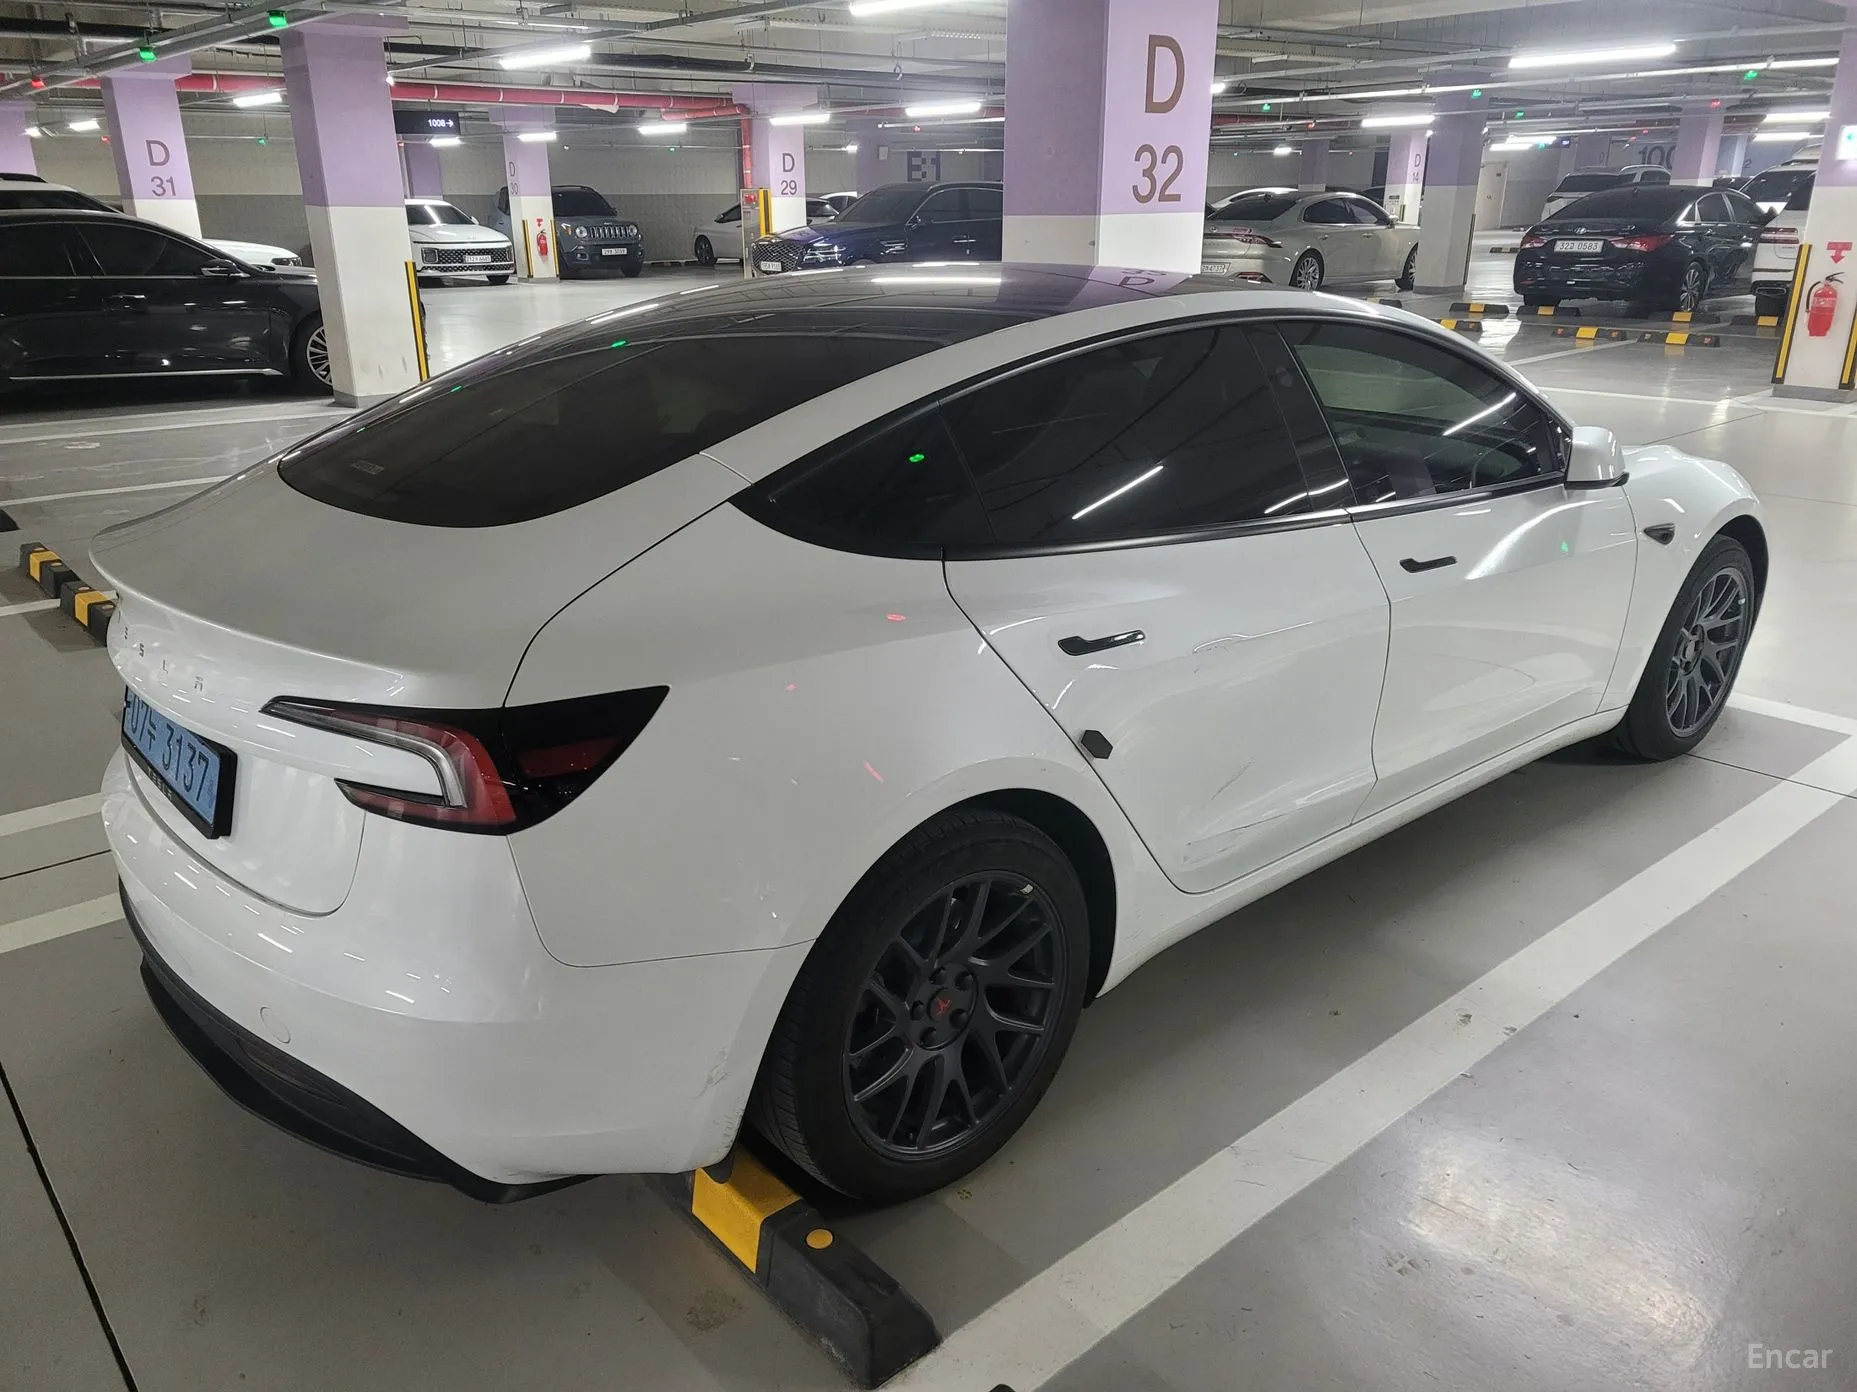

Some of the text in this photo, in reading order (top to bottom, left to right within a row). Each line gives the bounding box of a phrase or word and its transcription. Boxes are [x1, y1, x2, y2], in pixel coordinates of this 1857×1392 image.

[1144, 34, 1185, 113] D
[145, 139, 170, 166] D
[782, 153, 795, 172] D
[1414, 153, 1421, 167] D
[509, 161, 516, 177] D
[1132, 143, 1184, 204] 32
[151, 176, 176, 196] 31
[780, 180, 797, 195] 29
[162, 722, 210, 802] 3137
